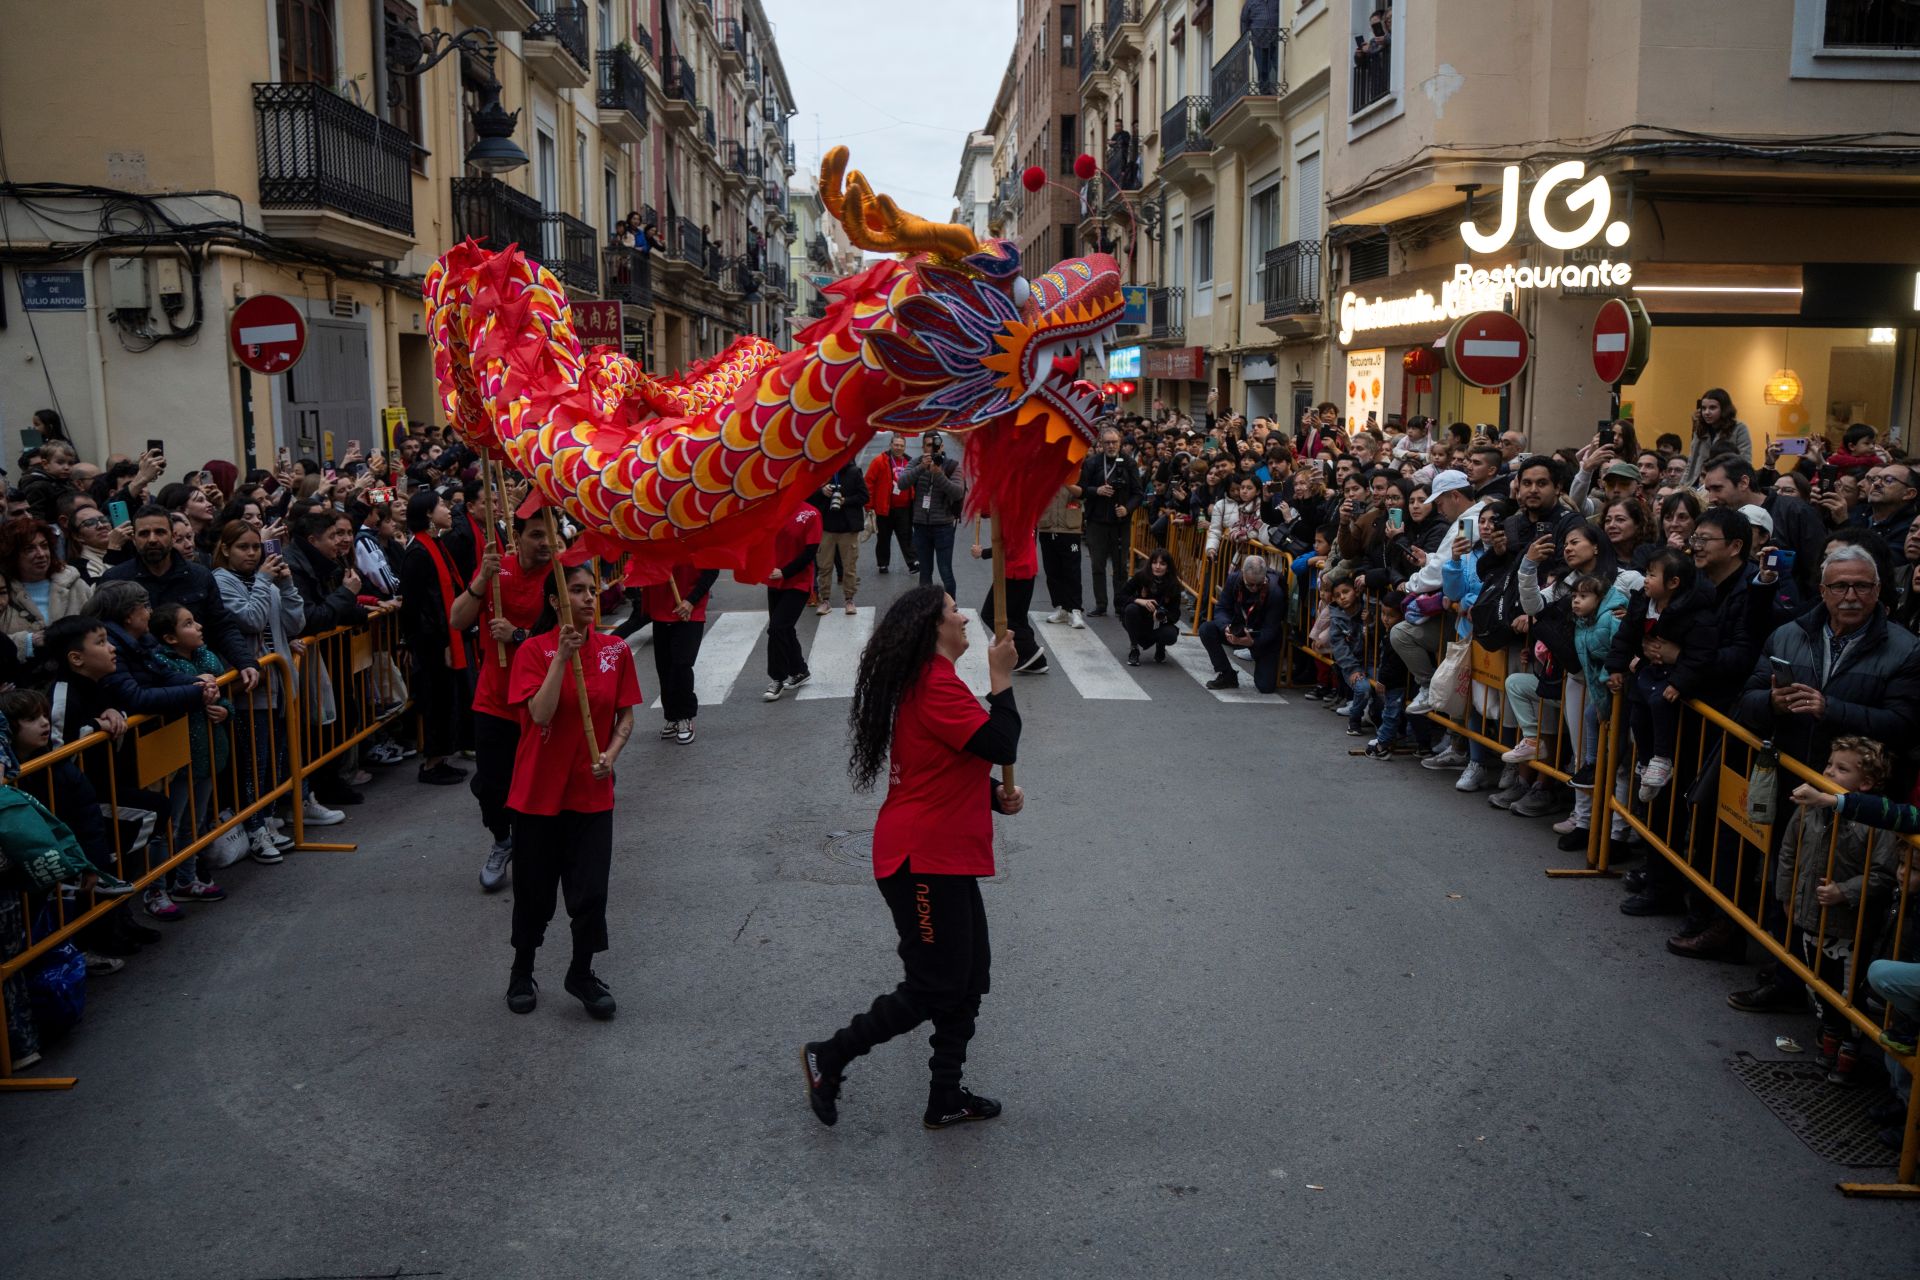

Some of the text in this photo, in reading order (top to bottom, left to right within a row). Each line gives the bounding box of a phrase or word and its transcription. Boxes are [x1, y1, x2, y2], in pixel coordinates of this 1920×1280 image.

[1454, 259, 1632, 289] Restaurante
[25, 297, 86, 305] JULIO ANTONIO
[915, 883, 936, 944] KUNGFU
